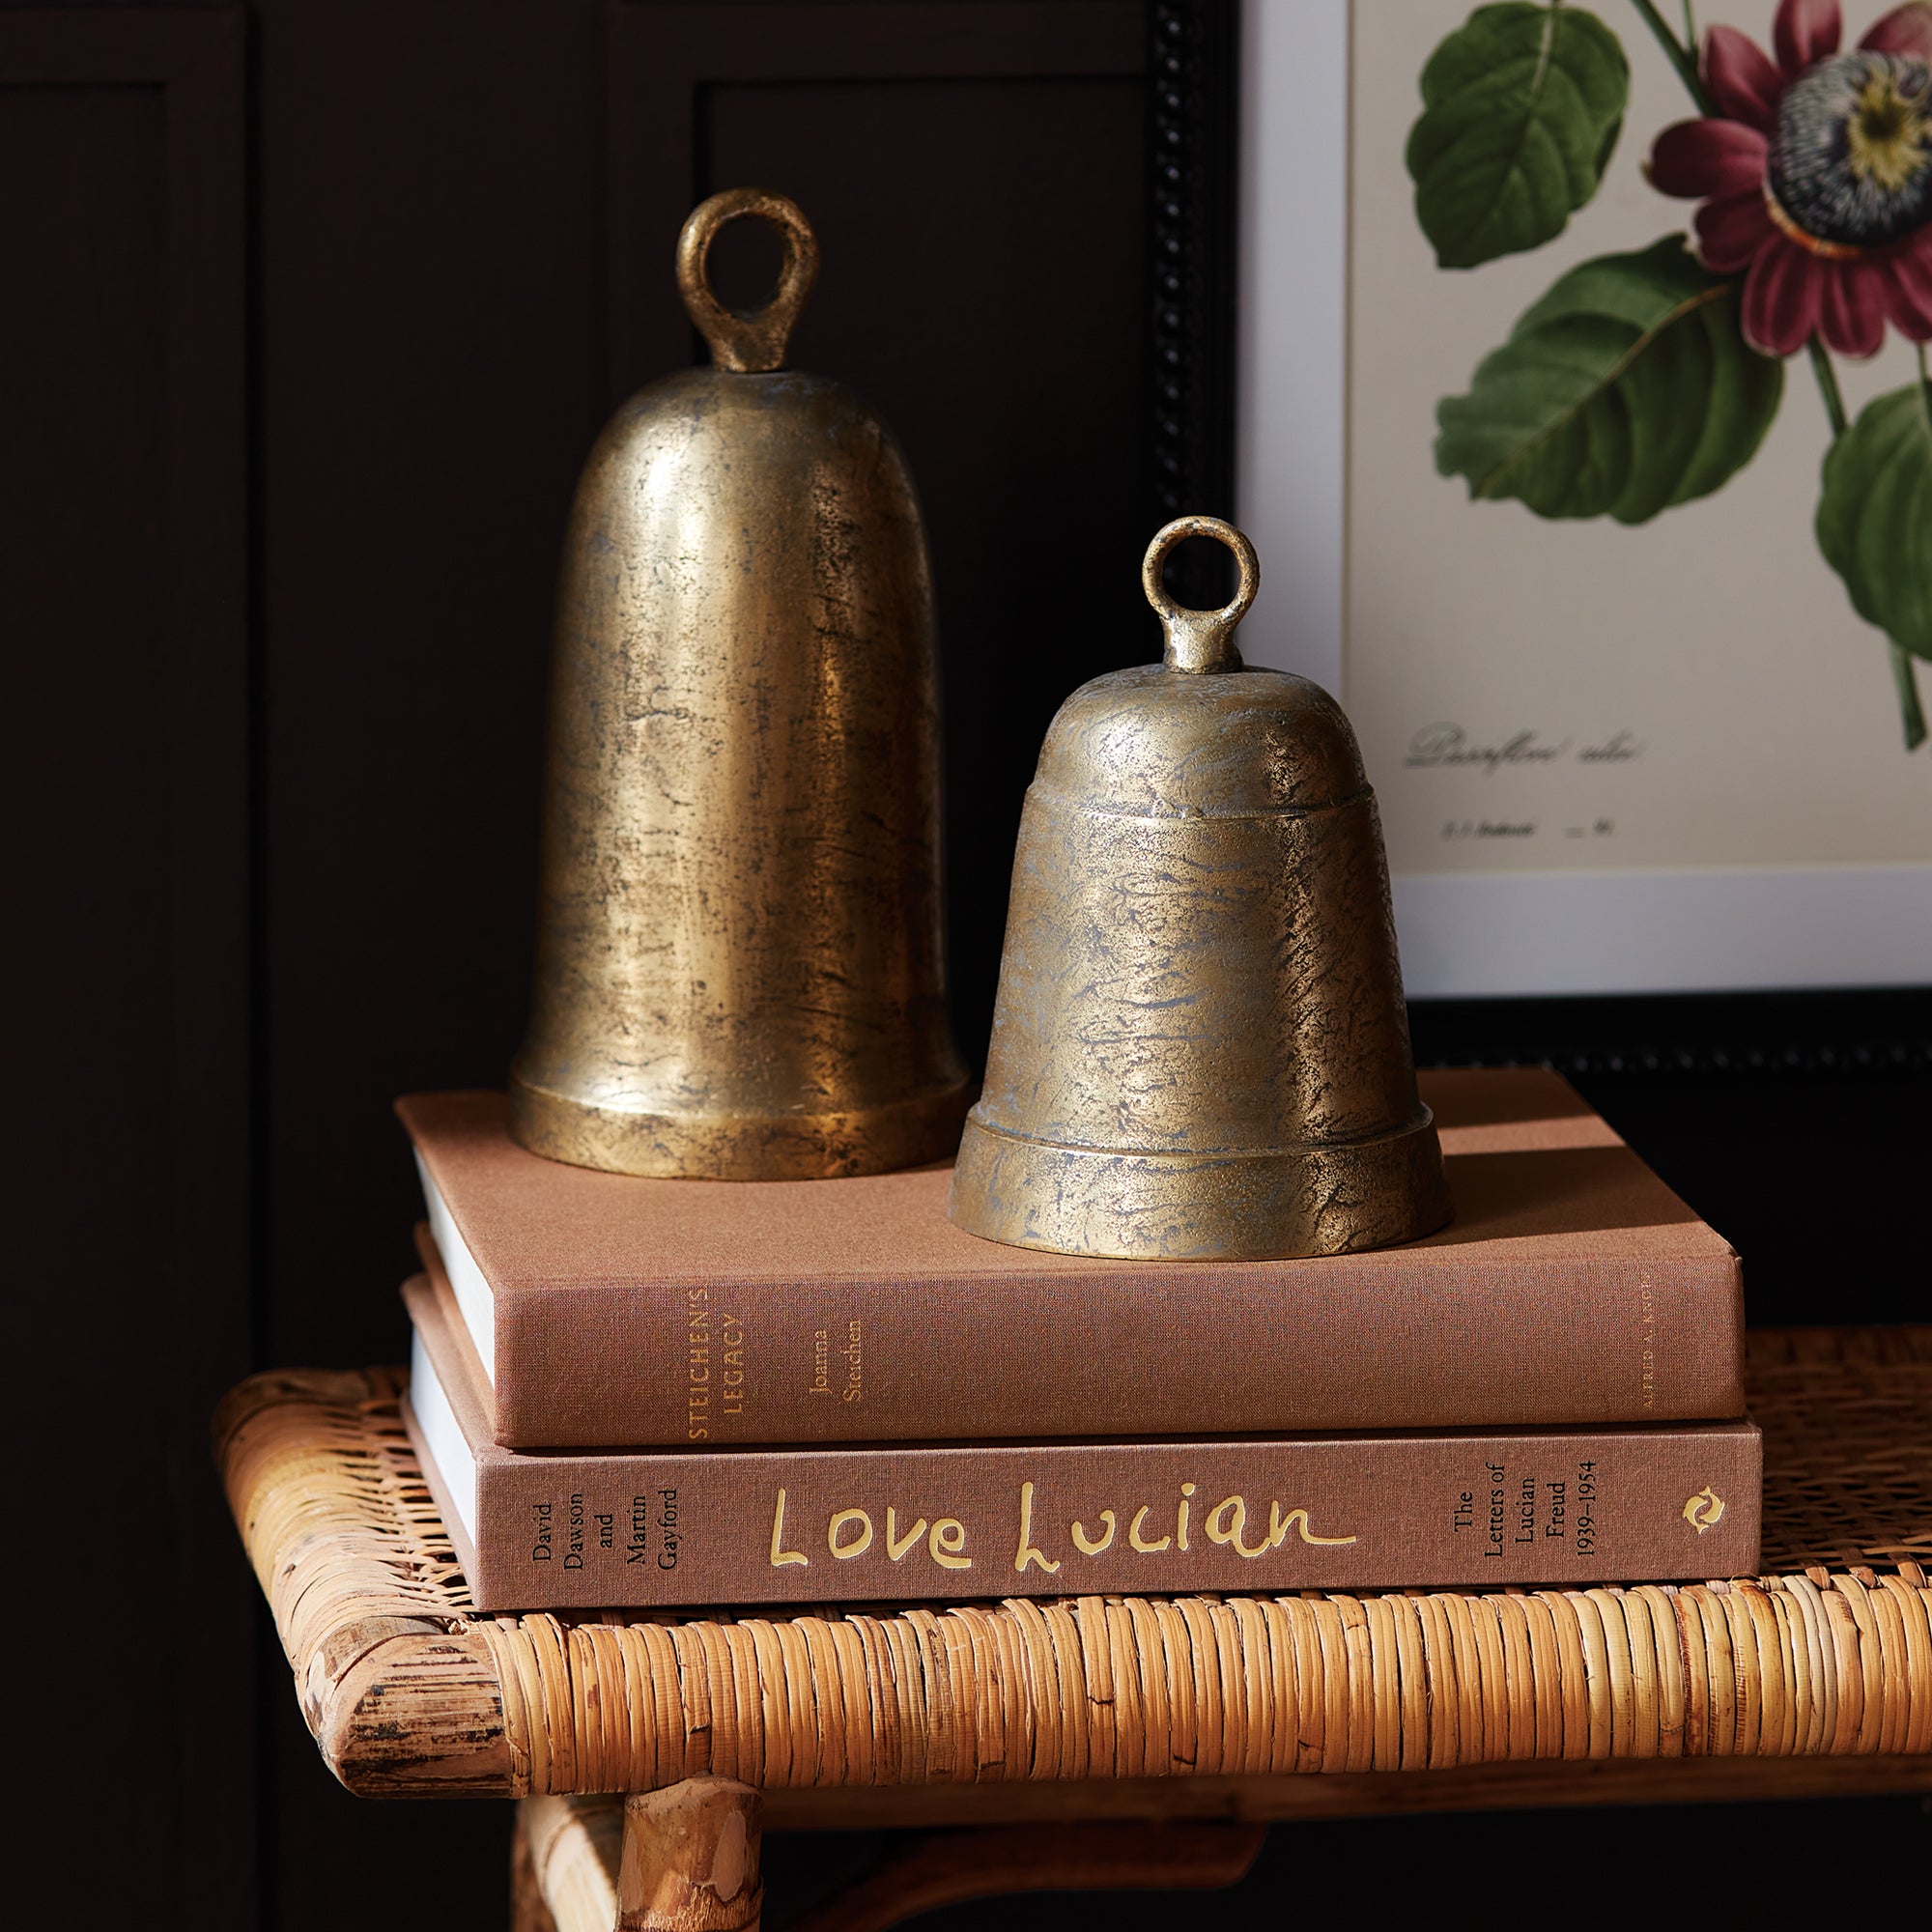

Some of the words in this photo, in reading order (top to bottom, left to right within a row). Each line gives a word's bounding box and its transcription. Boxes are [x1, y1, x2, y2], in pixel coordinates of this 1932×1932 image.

[688, 1287, 709, 1439] STEICHEN'S
[724, 1312, 744, 1414] LEGACY
[809, 1329, 833, 1395] Joanna
[839, 1318, 862, 1403] Steichen
[1485, 1462, 1505, 1484] of
[532, 1502, 553, 1562] David
[563, 1492, 584, 1571] Dawson
[593, 1513, 613, 1549] and
[626, 1494, 647, 1565] Martin
[657, 1489, 683, 1571] Gayford
[770, 1488, 972, 1569] Love
[1014, 1482, 1357, 1574] Lucian
[1454, 1491, 1474, 1533] The
[1484, 1489, 1504, 1558] Letters
[1515, 1477, 1535, 1544] Lucian
[1546, 1482, 1566, 1538] Freud
